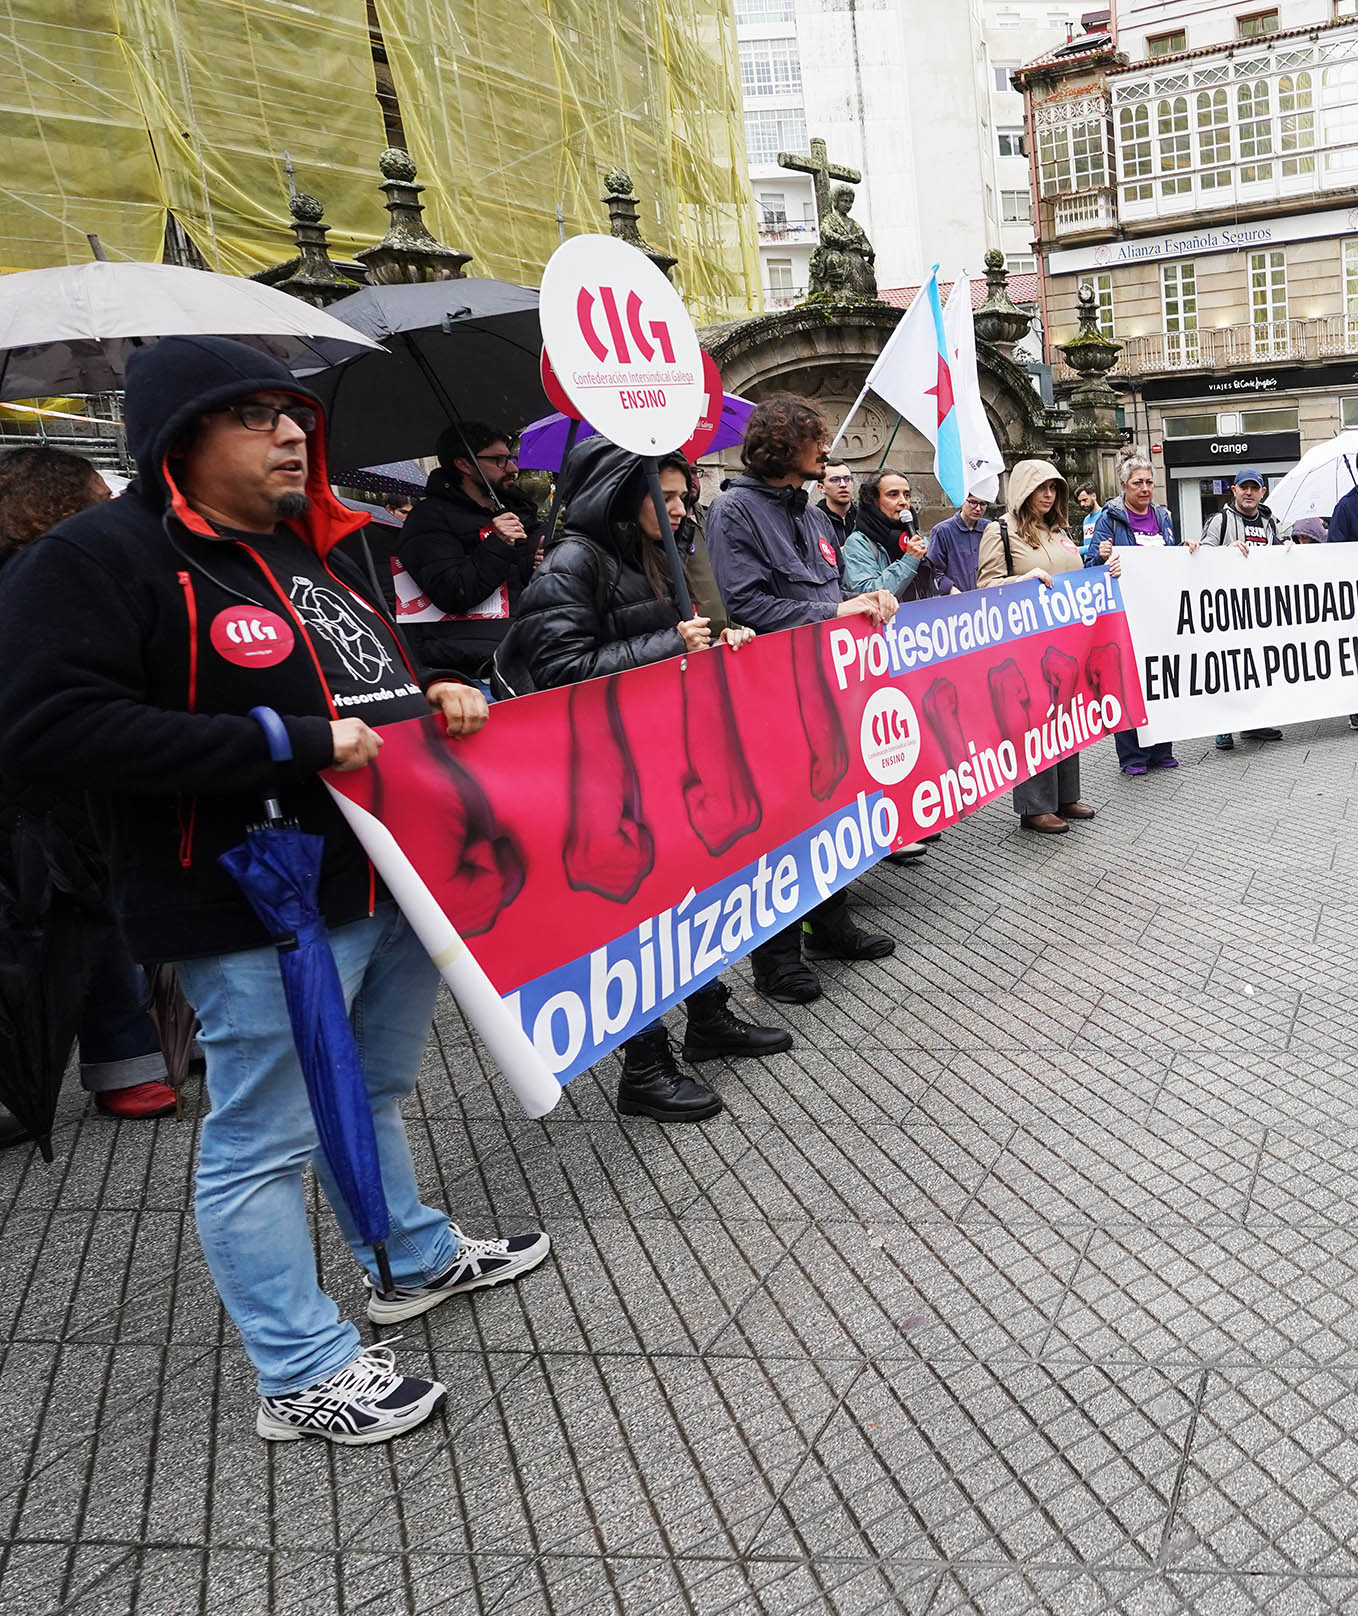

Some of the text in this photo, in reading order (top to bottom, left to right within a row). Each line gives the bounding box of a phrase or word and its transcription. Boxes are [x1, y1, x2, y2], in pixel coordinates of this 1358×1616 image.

[1117, 227, 1272, 260] Alianza Española Seguros
[576, 286, 676, 364] CIG
[572, 370, 694, 385] Confederación Intersindical Galega
[1208, 383, 1232, 392] VIAJES
[619, 389, 667, 410] ENSINO
[1210, 443, 1248, 456] Orange
[1176, 590, 1196, 636] A
[226, 619, 278, 644] CIG
[829, 571, 1117, 691] Profesorado en folga!
[1146, 654, 1180, 702] EN
[1189, 647, 1261, 697] LOITA
[1264, 640, 1331, 687] POLO
[872, 709, 910, 747] CIG
[881, 752, 905, 769] ENSINO
[510, 693, 1122, 1074] obilízate polo ensino público
